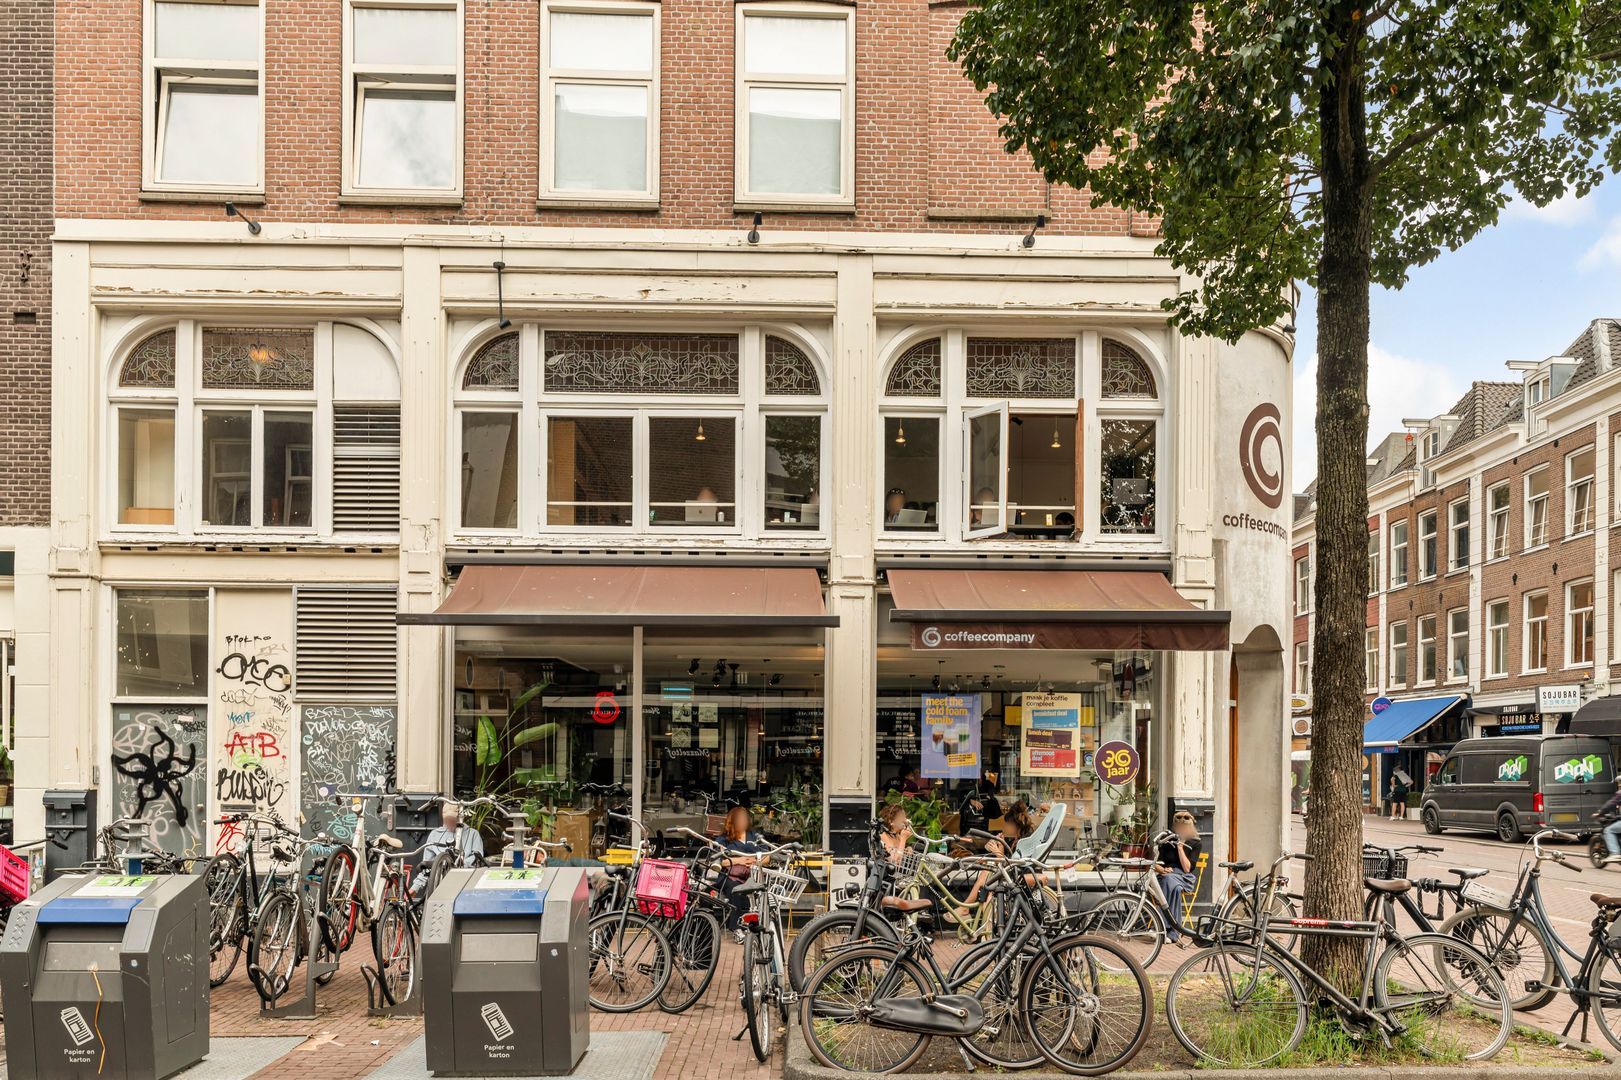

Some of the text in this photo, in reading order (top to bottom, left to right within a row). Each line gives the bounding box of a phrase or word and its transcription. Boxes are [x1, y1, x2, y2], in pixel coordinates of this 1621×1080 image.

[944, 631, 1035, 643] coffeecompany
[925, 696, 964, 707] meet the
[925, 706, 945, 716] cold
[946, 706, 968, 716] foam
[925, 716, 954, 727] family
[1107, 766, 1130, 778] jaar
